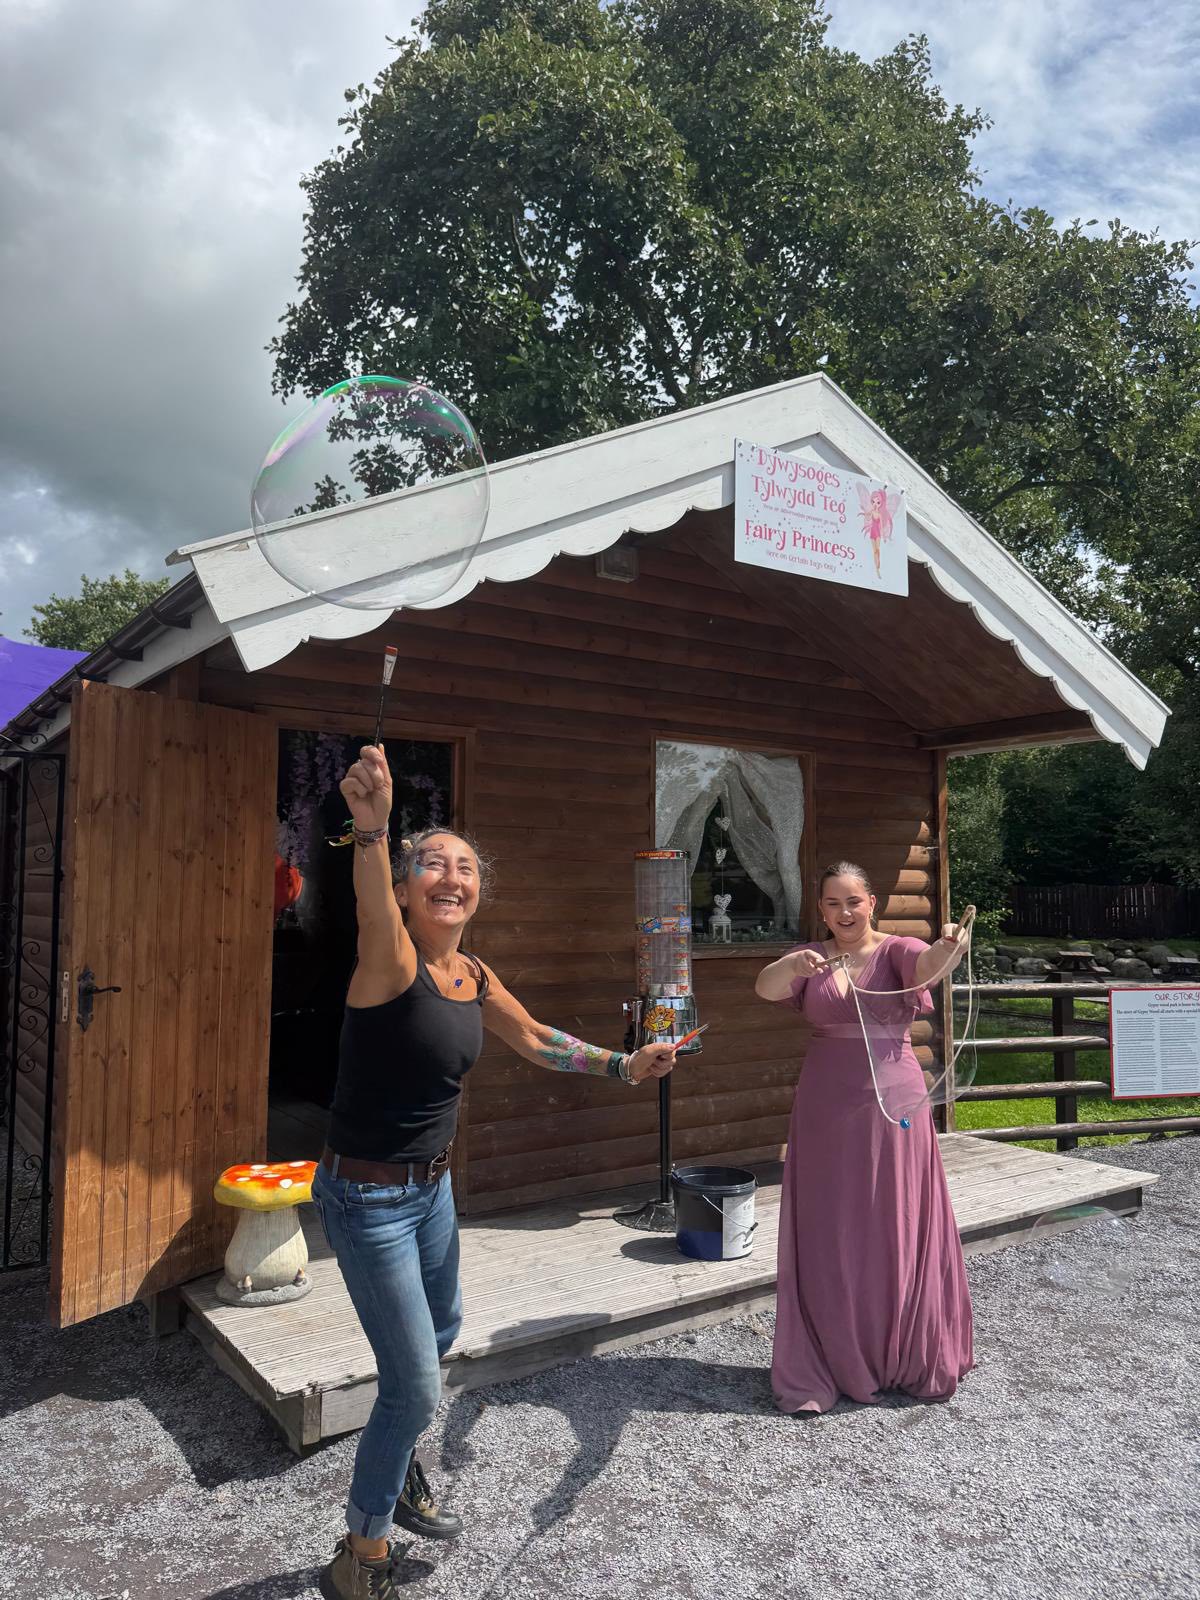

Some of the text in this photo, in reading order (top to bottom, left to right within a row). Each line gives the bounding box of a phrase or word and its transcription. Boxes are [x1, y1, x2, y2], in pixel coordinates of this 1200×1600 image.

[757, 448, 840, 492] Dywysoges
[752, 474, 846, 524] Tylwydd Teg
[745, 519, 856, 561] Fairy Princess
[1154, 992, 1200, 1001] OUR STORY
